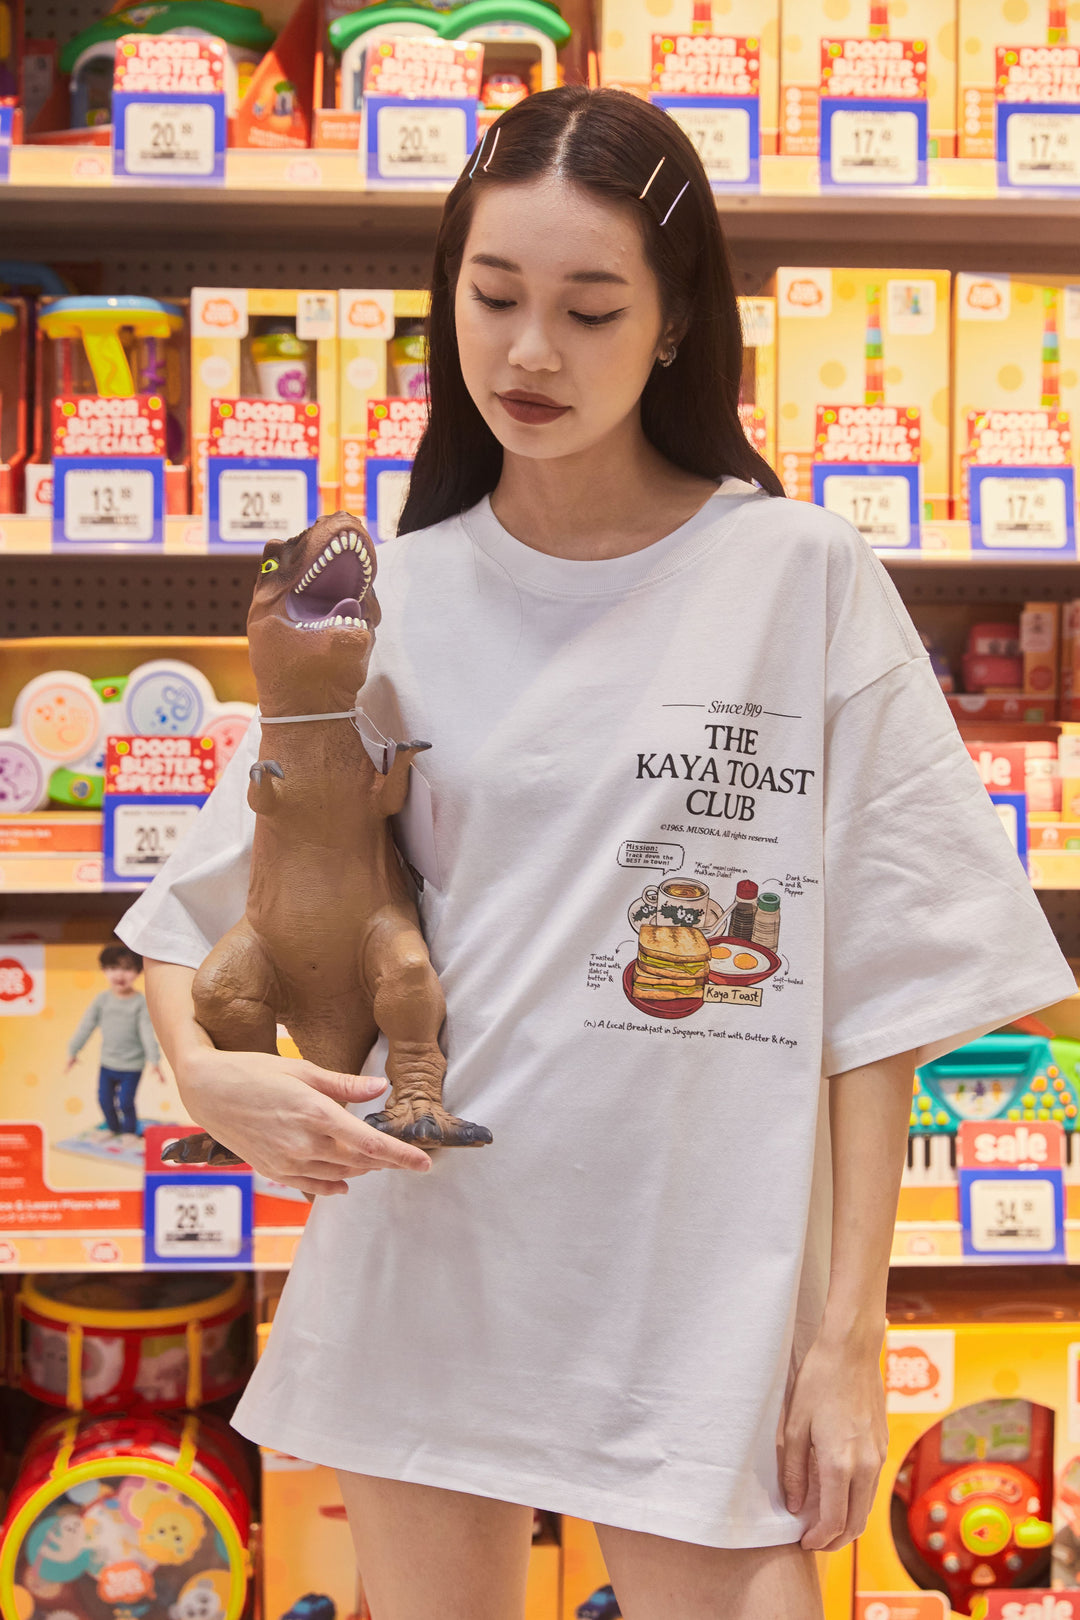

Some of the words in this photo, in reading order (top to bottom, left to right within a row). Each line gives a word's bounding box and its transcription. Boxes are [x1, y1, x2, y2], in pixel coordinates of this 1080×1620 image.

[140, 42, 199, 59] DOOR
[395, 43, 455, 63] DOOR
[676, 36, 736, 55] DOOR
[844, 41, 903, 58] DOOR
[127, 58, 209, 75] BUSTER
[664, 53, 746, 75] BUSTER
[833, 57, 915, 76] BUSTER
[1020, 48, 1078, 66] DOOR
[382, 58, 465, 80] BUSTER
[122, 74, 215, 91] SPECIALS
[376, 74, 468, 96] SPECIALS
[660, 72, 752, 94] SPECIALS
[828, 76, 919, 97] SPECIALS
[78, 400, 139, 417] DOOR
[235, 402, 295, 421] DOOR
[838, 407, 897, 426] DOOR
[67, 417, 149, 435] BUSTER
[223, 420, 304, 441] BUSTER
[990, 412, 1049, 431] DOOR
[63, 434, 155, 454] SPECIALS
[827, 424, 908, 445] BUSTER
[980, 429, 1060, 449] BUSTER
[217, 437, 309, 457] SPECIALS
[822, 443, 912, 462] SPECIALS
[976, 446, 1066, 465] SPECIALS
[708, 700, 743, 715] Since
[742, 702, 763, 718] 1919
[131, 739, 191, 757] DOOR
[704, 724, 758, 755] THE
[120, 756, 201, 775] BUSTER
[635, 753, 720, 784] KAYA
[727, 759, 815, 795] TOAST
[972, 751, 1012, 786] le
[115, 774, 206, 793] SPECIALS
[686, 789, 756, 821] CLUB
[722, 830, 730, 838] All
[730, 831, 747, 841] rights
[748, 835, 779, 844] reserved.
[626, 843, 658, 852] Mission:
[802, 876, 818, 884] Sauce
[785, 888, 804, 897] Pepper
[590, 953, 614, 961] Toasted
[706, 987, 729, 1001] Kaya
[731, 989, 759, 1002] Toast
[598, 1020, 605, 1028] A
[606, 1021, 625, 1030] Local
[626, 1023, 663, 1034] Breakfast
[672, 1027, 705, 1038] Singapore,
[708, 1029, 726, 1038] Toast
[728, 1032, 743, 1040] with
[745, 1033, 770, 1042] Butter
[771, 1035, 778, 1044] &
[779, 1036, 798, 1048] Kaya
[974, 1127, 1048, 1162] sale
[1001, 1595, 1074, 1620] sale
